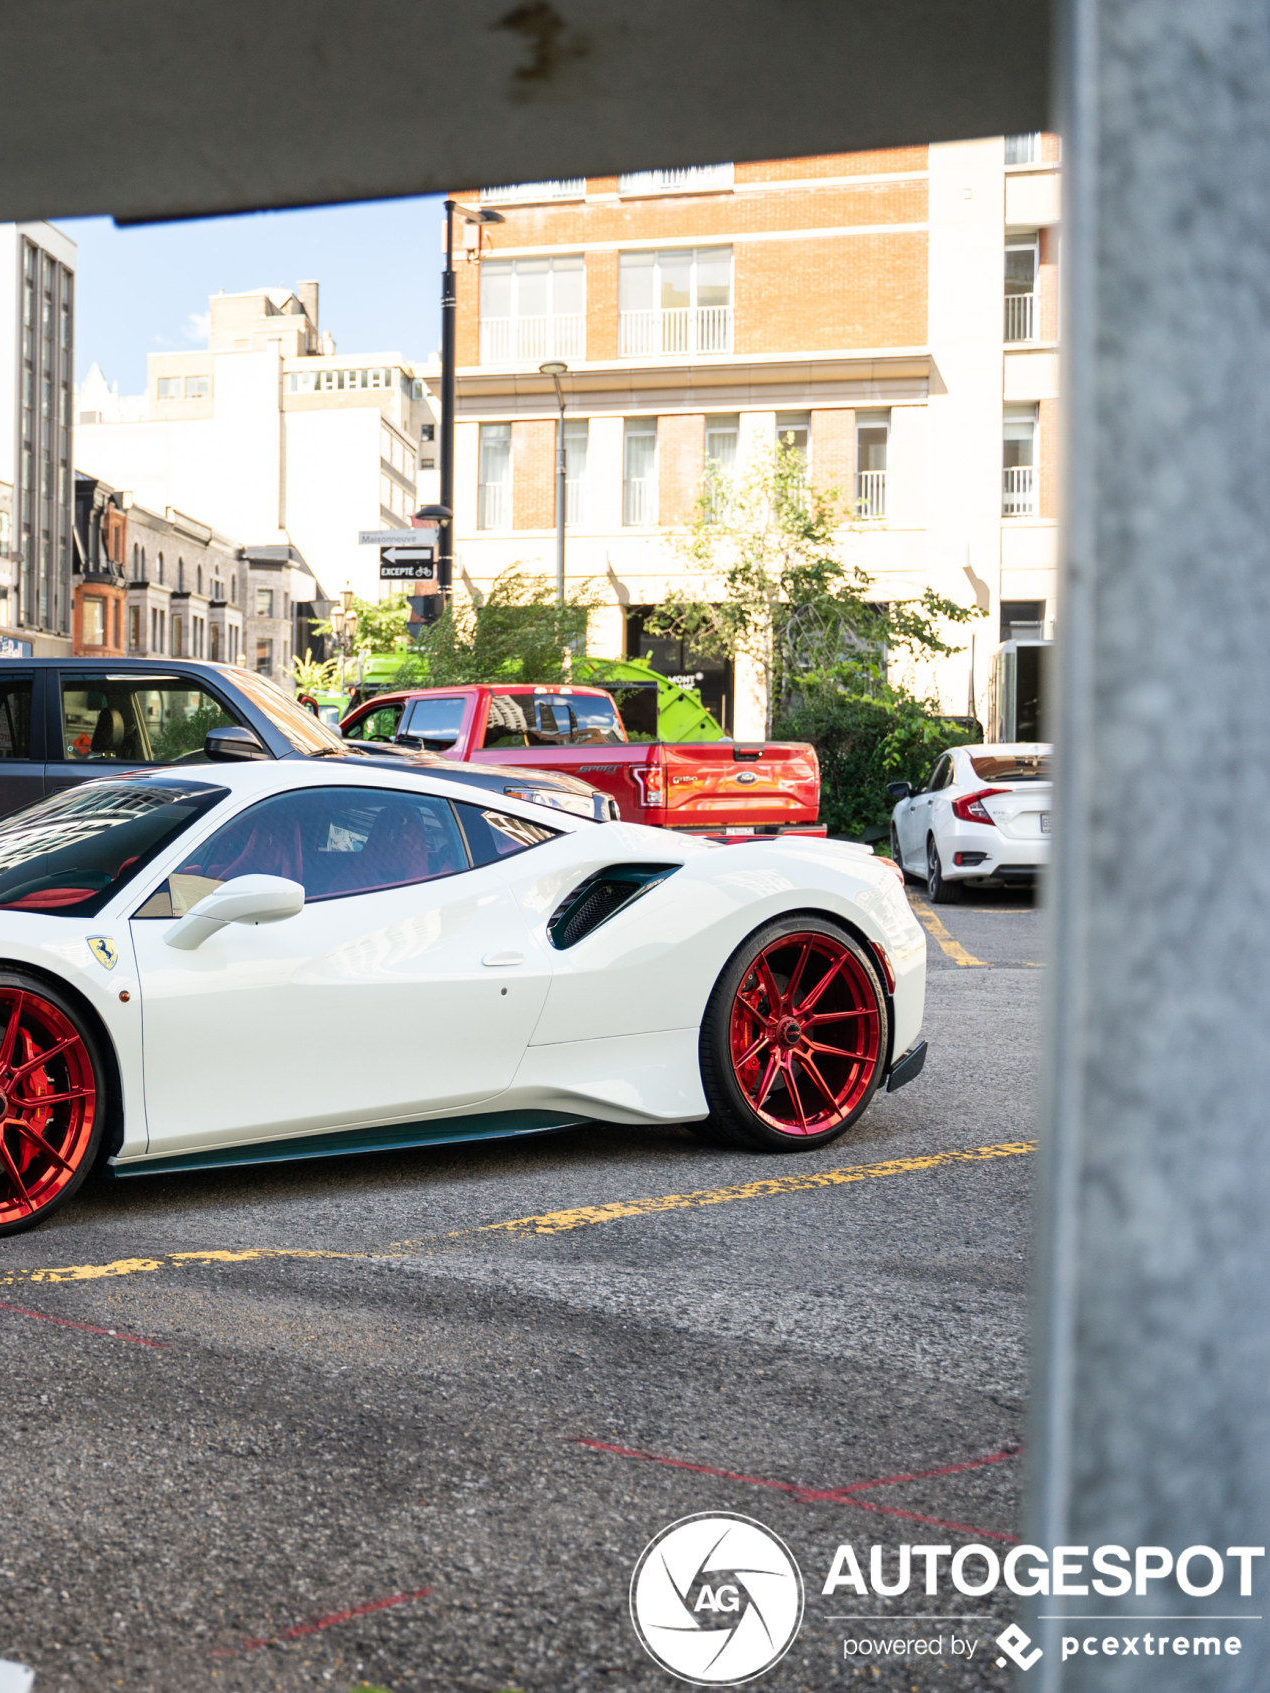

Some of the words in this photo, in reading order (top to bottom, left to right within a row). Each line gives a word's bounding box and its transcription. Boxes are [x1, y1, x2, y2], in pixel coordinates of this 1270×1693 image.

[361, 535, 417, 544] Maisonneuve
[381, 566, 414, 577] EXCEPTÉ
[575, 764, 623, 774] SPORT
